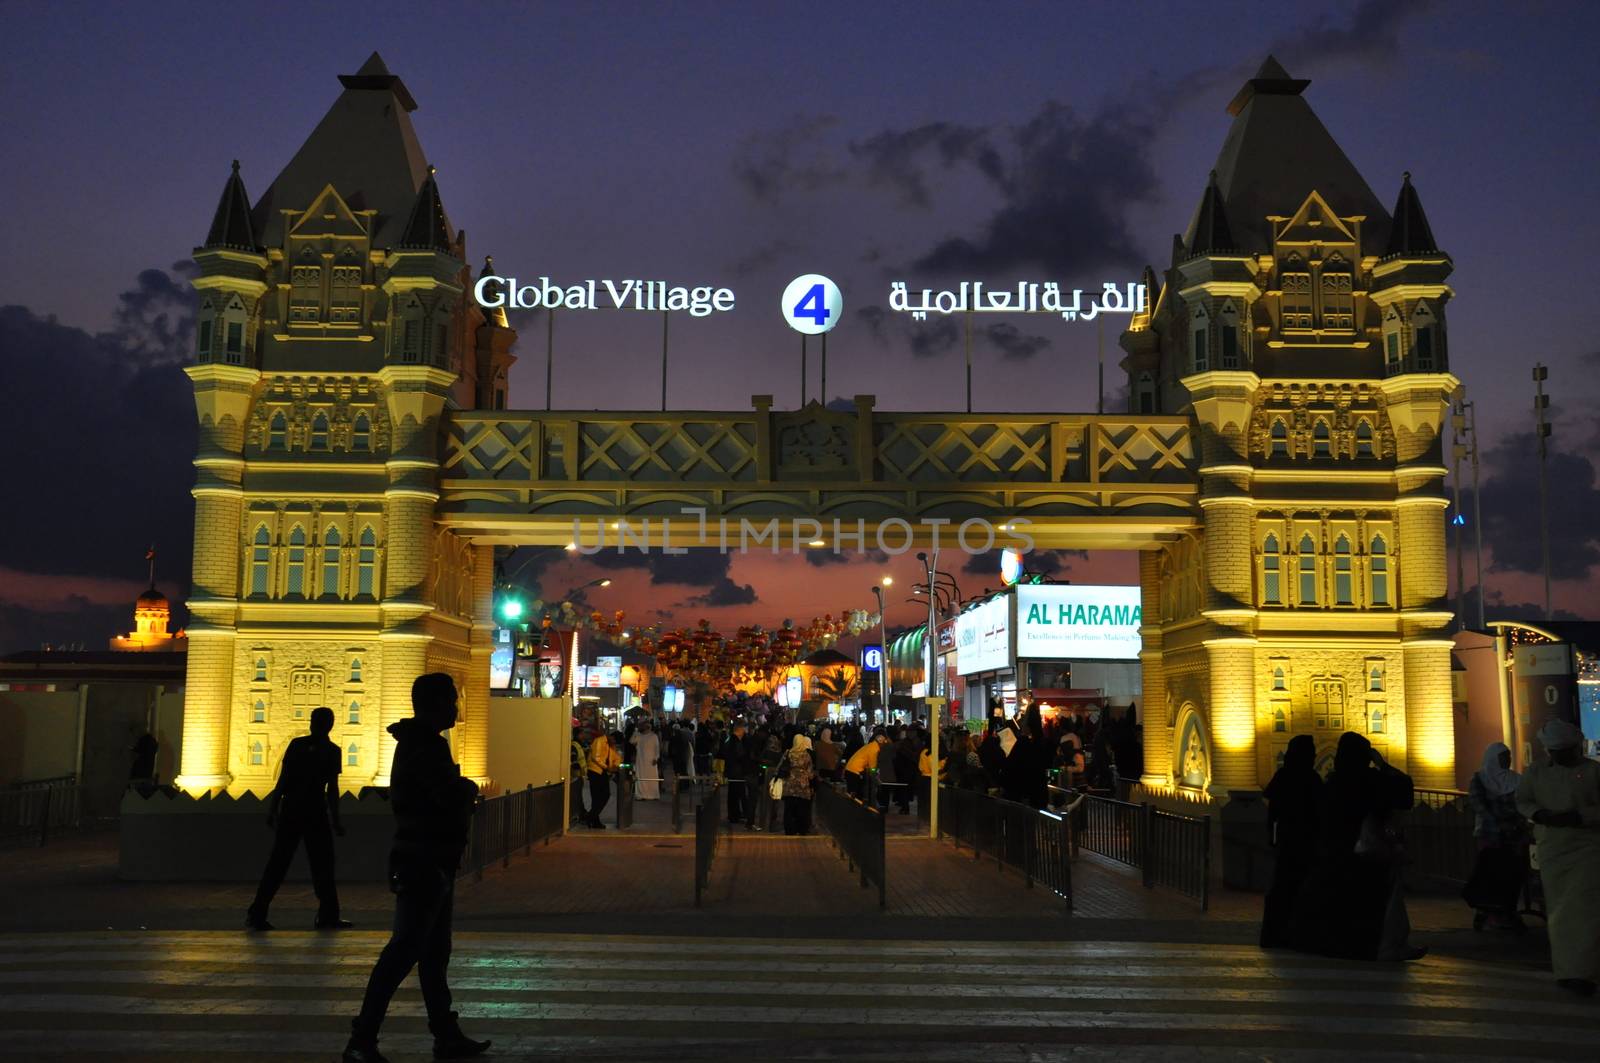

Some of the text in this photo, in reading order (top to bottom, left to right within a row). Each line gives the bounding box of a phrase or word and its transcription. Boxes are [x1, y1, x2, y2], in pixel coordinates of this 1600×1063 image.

[475, 275, 735, 317] Global Village
[793, 283, 831, 325] 4
[889, 281, 1146, 321] القرية العالمية
[1027, 604, 1052, 624] AL
[1073, 632, 1101, 641] Perfume
[1104, 633, 1130, 642] Making
